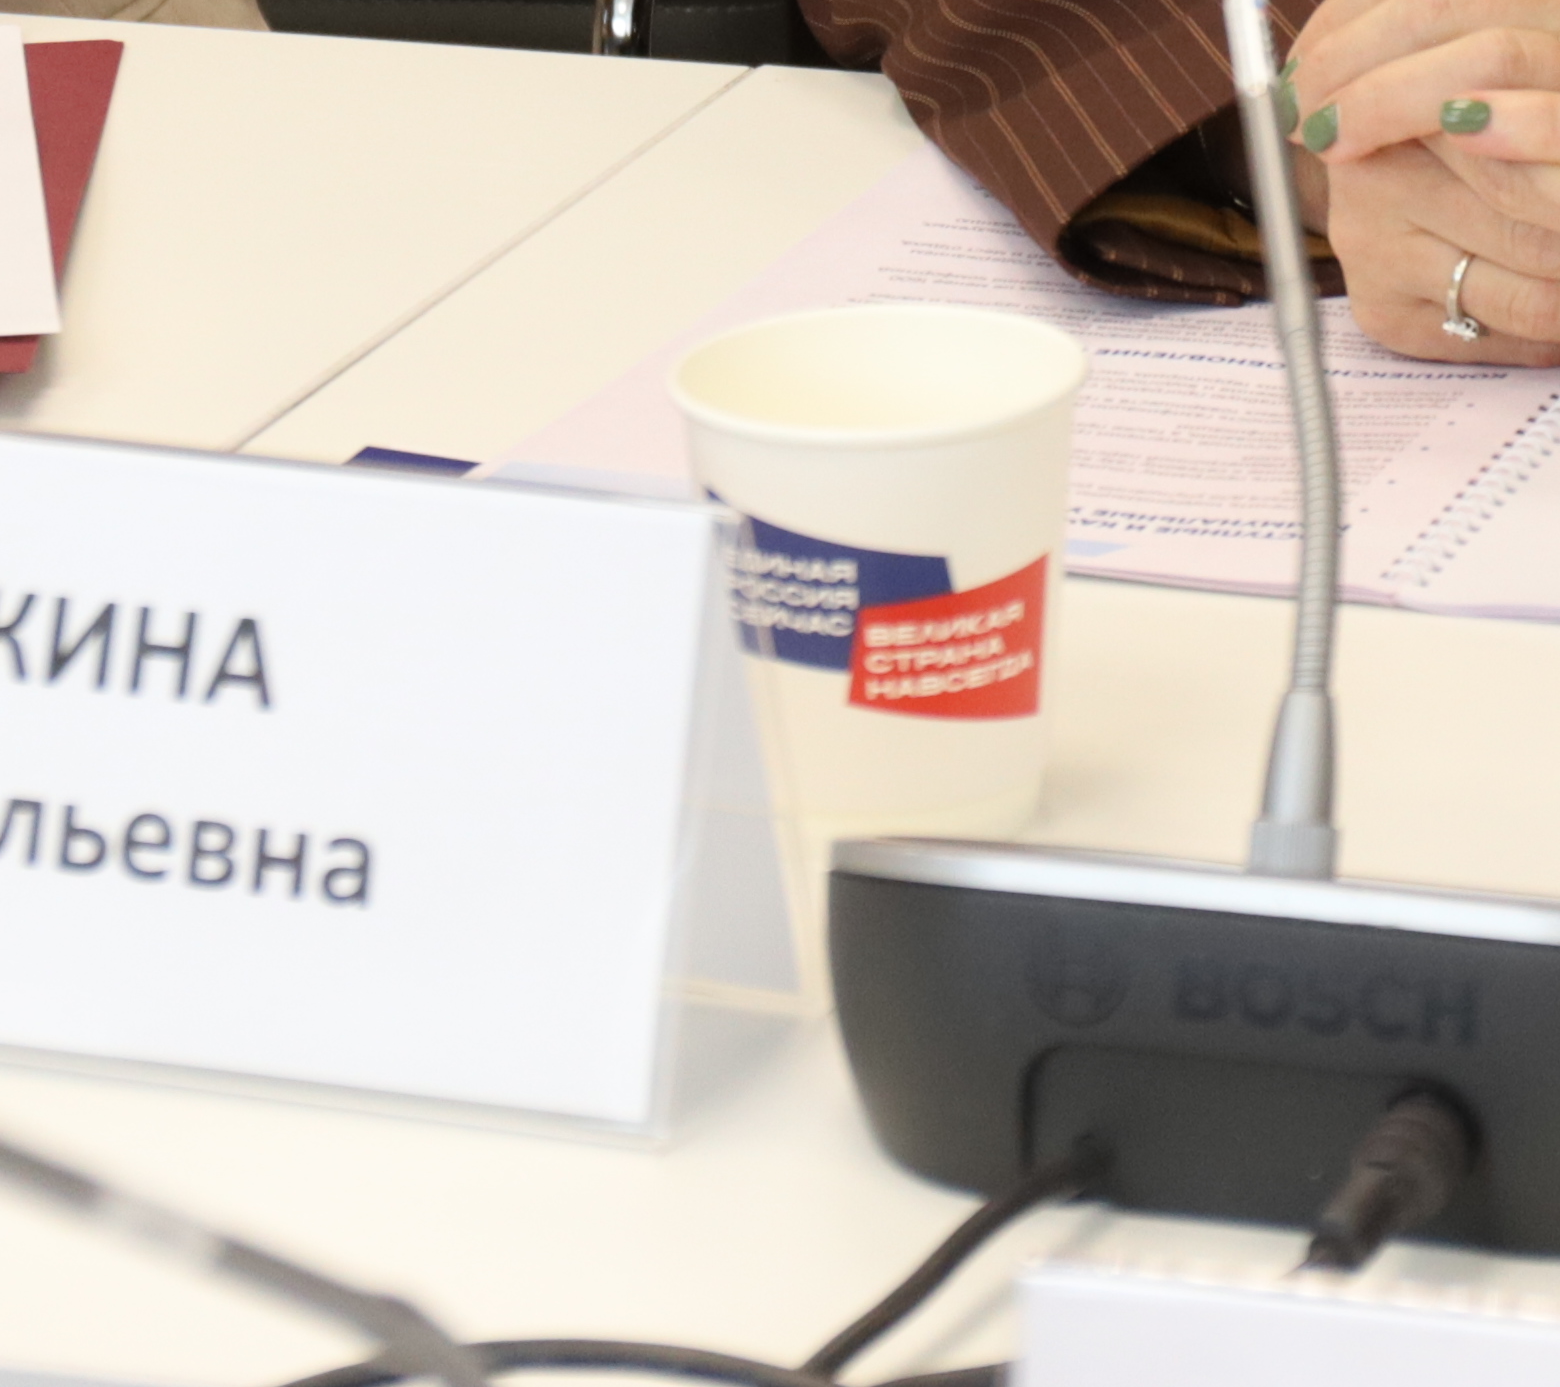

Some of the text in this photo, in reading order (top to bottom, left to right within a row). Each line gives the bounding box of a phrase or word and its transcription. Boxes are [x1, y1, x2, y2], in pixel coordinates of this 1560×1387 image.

[1094, 349, 1508, 380] КОМПЛЕКСН ОБНОВЛЕНИЕ
[1155, 527, 1306, 541] СТУПНЫЕ
[863, 633, 1007, 675] СТРАНА
[1172, 956, 1481, 1049] BOSCH
